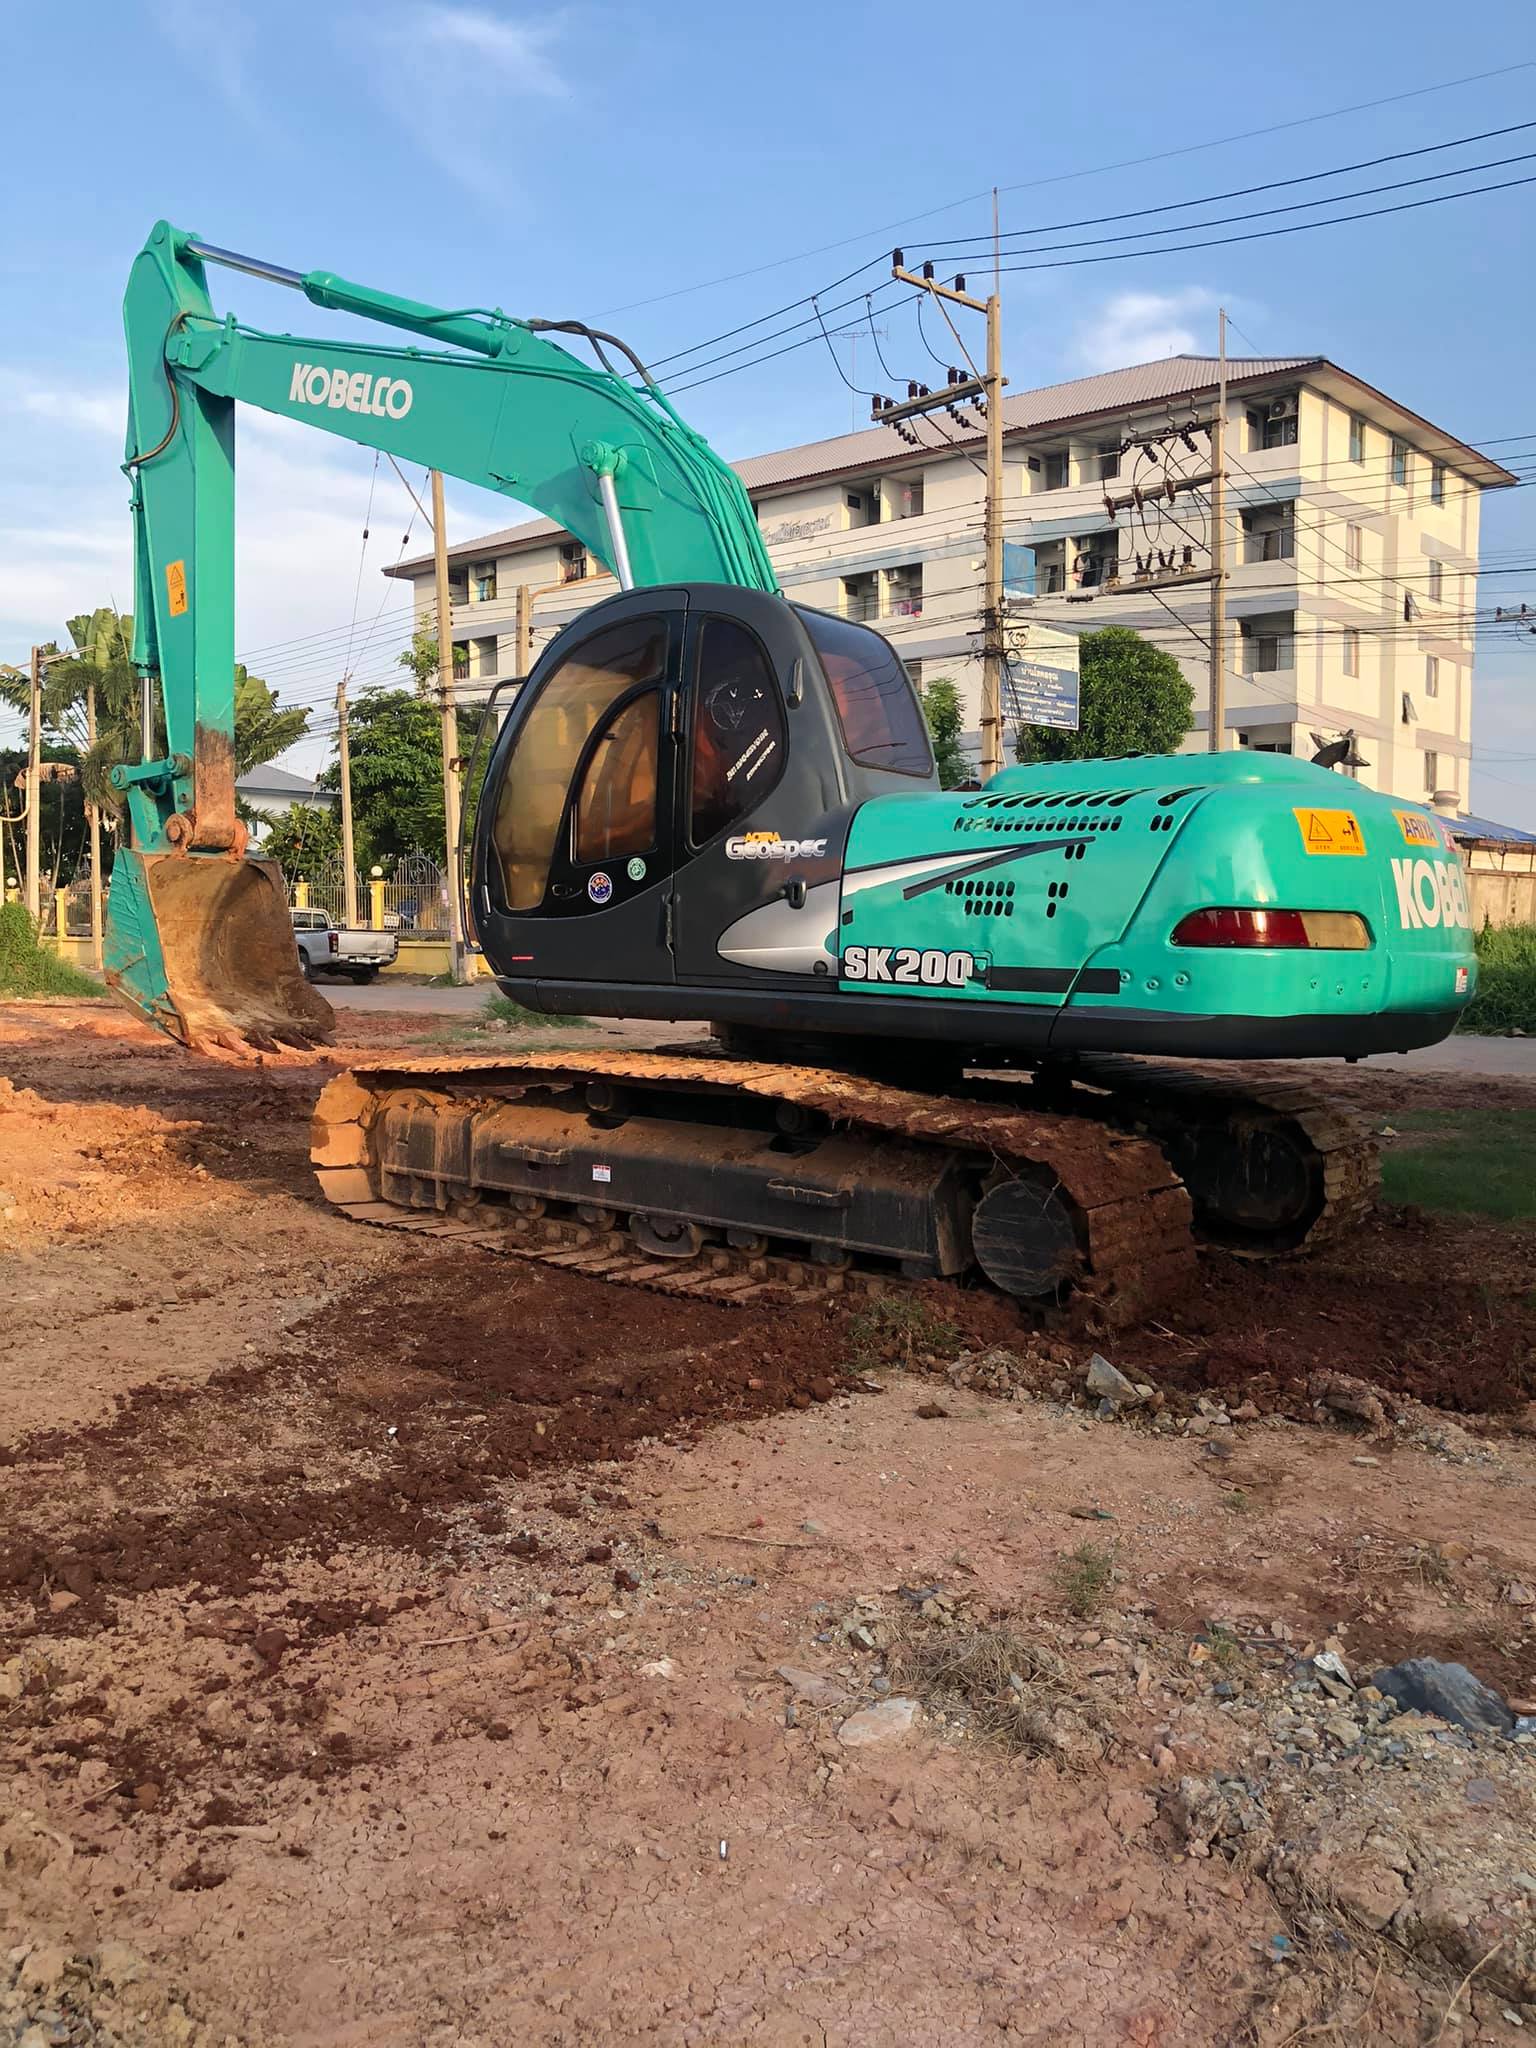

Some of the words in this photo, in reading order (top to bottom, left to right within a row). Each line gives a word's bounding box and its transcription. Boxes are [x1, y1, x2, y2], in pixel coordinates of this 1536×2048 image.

[289, 363, 413, 420] KOBELCO
[725, 836, 828, 864] Geospec
[843, 947, 974, 987] SK200
